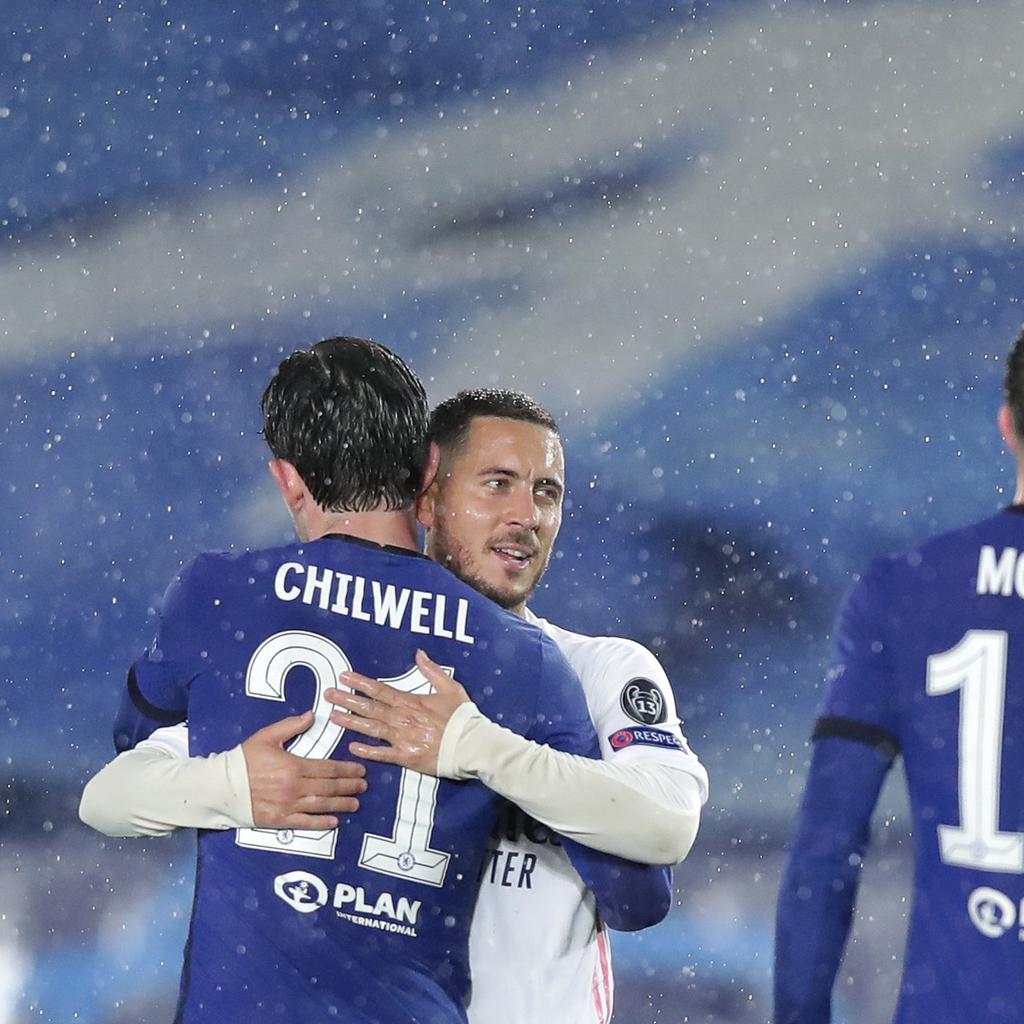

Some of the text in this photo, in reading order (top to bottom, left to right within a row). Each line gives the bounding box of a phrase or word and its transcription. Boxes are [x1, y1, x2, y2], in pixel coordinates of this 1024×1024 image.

[274, 562, 475, 645] CHILWELL
[637, 700, 656, 715] 13
[235, 629, 455, 888] 21
[332, 882, 422, 925] PLAN
[336, 910, 418, 938] INTERNATIONAL
